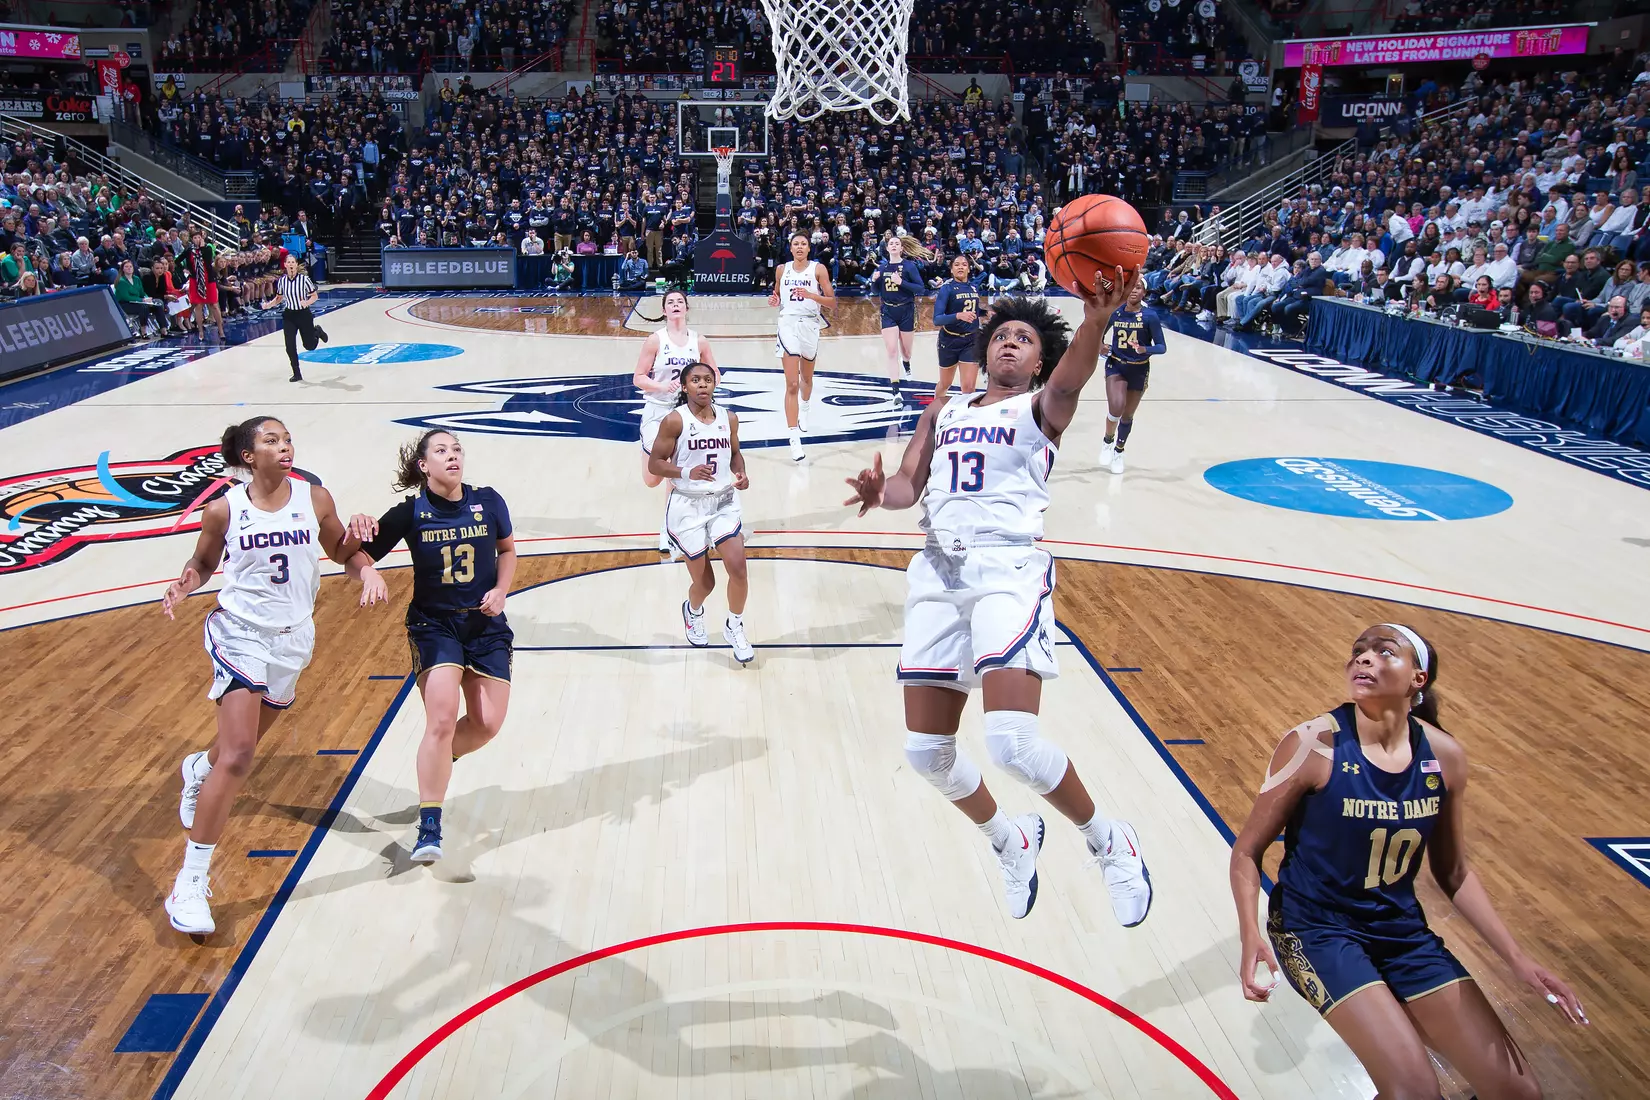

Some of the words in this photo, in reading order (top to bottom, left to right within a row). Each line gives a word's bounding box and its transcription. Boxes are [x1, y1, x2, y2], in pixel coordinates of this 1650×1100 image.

[1346, 41, 1376, 52] NEW
[1378, 37, 1434, 51] HOLIDAY
[1436, 33, 1510, 48] SIGNATURE
[1354, 51, 1400, 63] LATTES
[1402, 48, 1439, 60] FROM
[711, 61, 735, 82] 27
[1252, 77, 1268, 85] 205
[47, 95, 92, 112] Coke
[401, 91, 418, 99] 202
[56, 112, 85, 121] zero
[1341, 102, 1402, 117] UCONN
[390, 260, 508, 276] #BLEEDBLUE
[694, 273, 750, 283] TRAVELERS
[962, 299, 977, 314] 21
[0, 309, 94, 354] LEEDBLUE
[1117, 329, 1139, 349] 24
[1248, 349, 1437, 392] UCONN
[688, 438, 731, 450] UCONN
[935, 426, 1017, 450] UCONN
[706, 453, 718, 476] 5
[948, 450, 986, 494] 13
[239, 529, 311, 551] UCONN
[421, 530, 458, 544] NOTRE
[460, 524, 489, 540] DAME
[269, 552, 290, 585] 3
[439, 543, 476, 585] 13
[1342, 797, 1399, 821] NOTRE
[1403, 796, 1441, 820] DAME
[1364, 827, 1422, 890] 10
